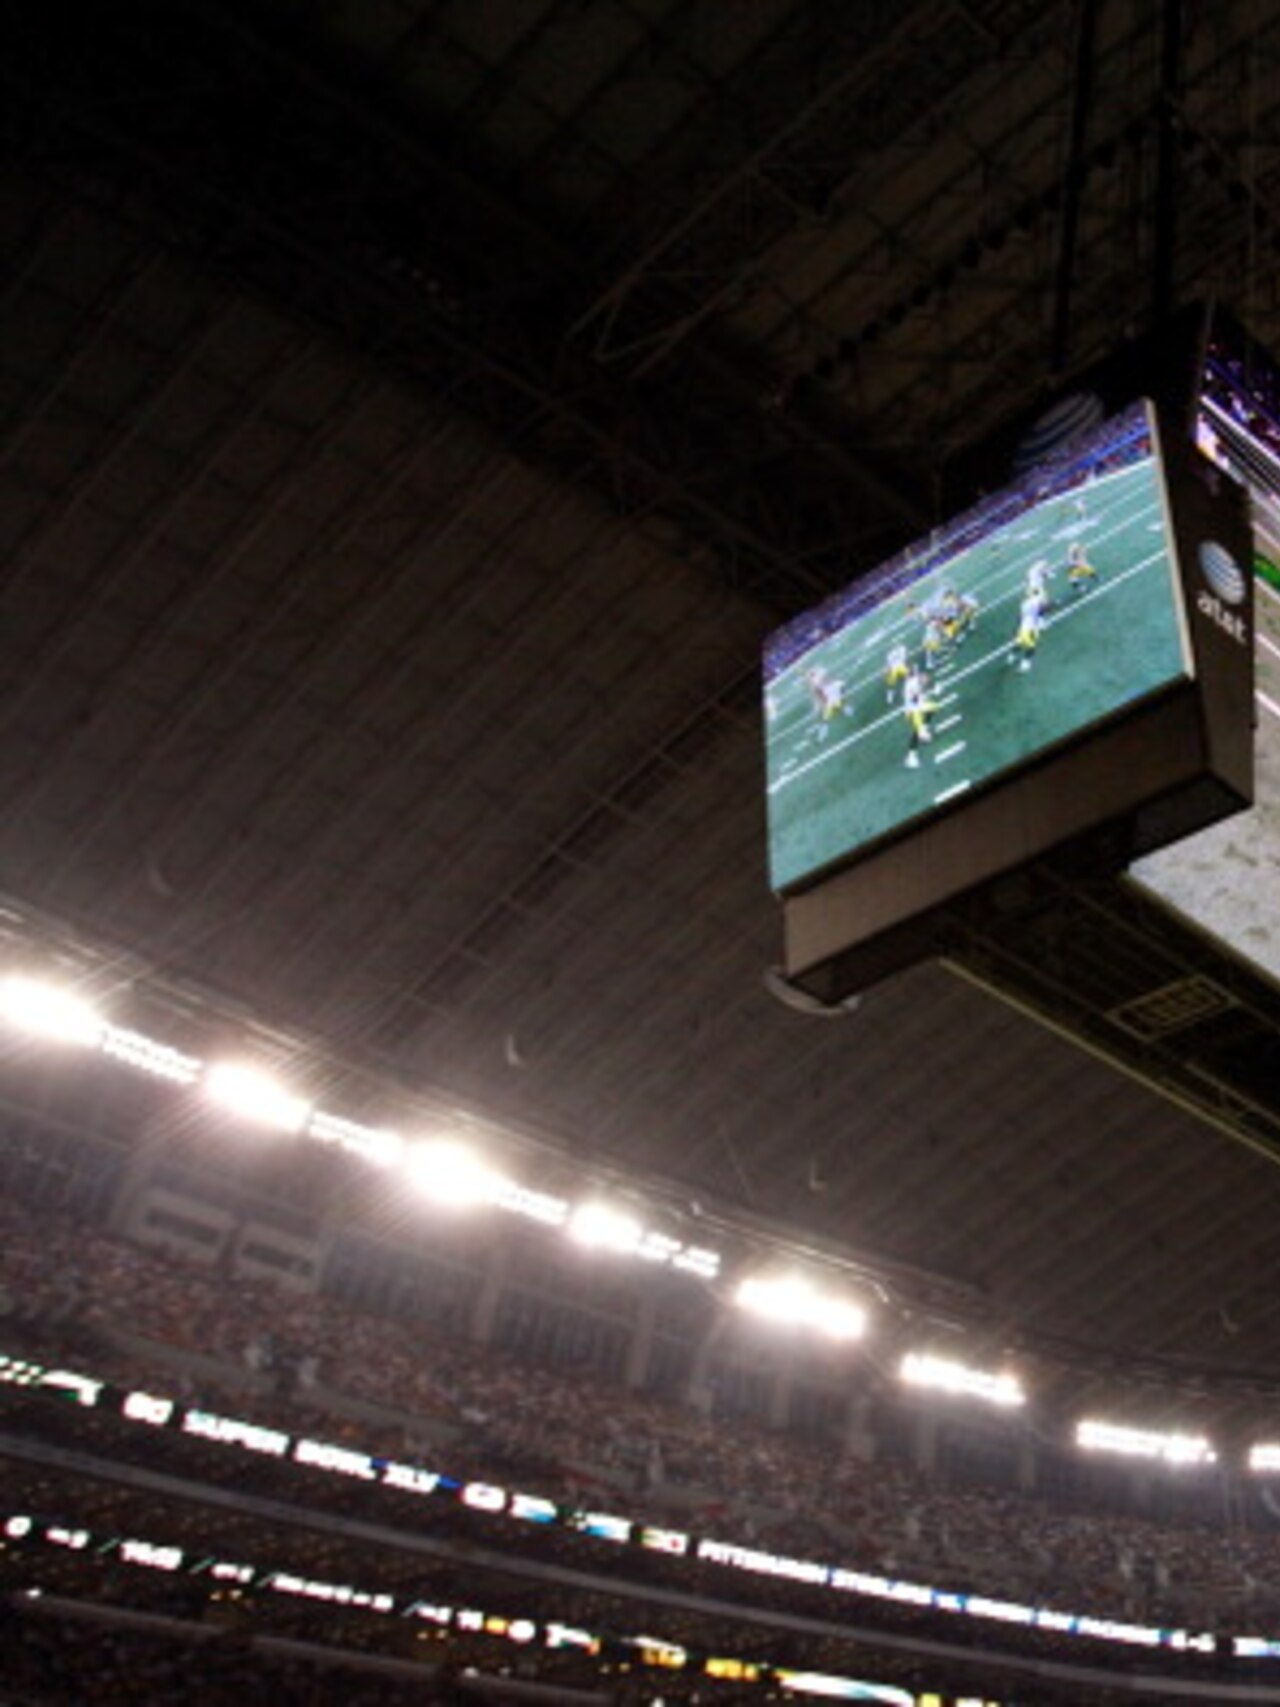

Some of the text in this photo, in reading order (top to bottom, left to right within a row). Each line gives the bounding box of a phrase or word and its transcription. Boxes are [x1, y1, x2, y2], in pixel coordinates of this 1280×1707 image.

[1197, 590, 1247, 645] at&t
[184, 1410, 439, 1492] SUPER BOWL XLV
